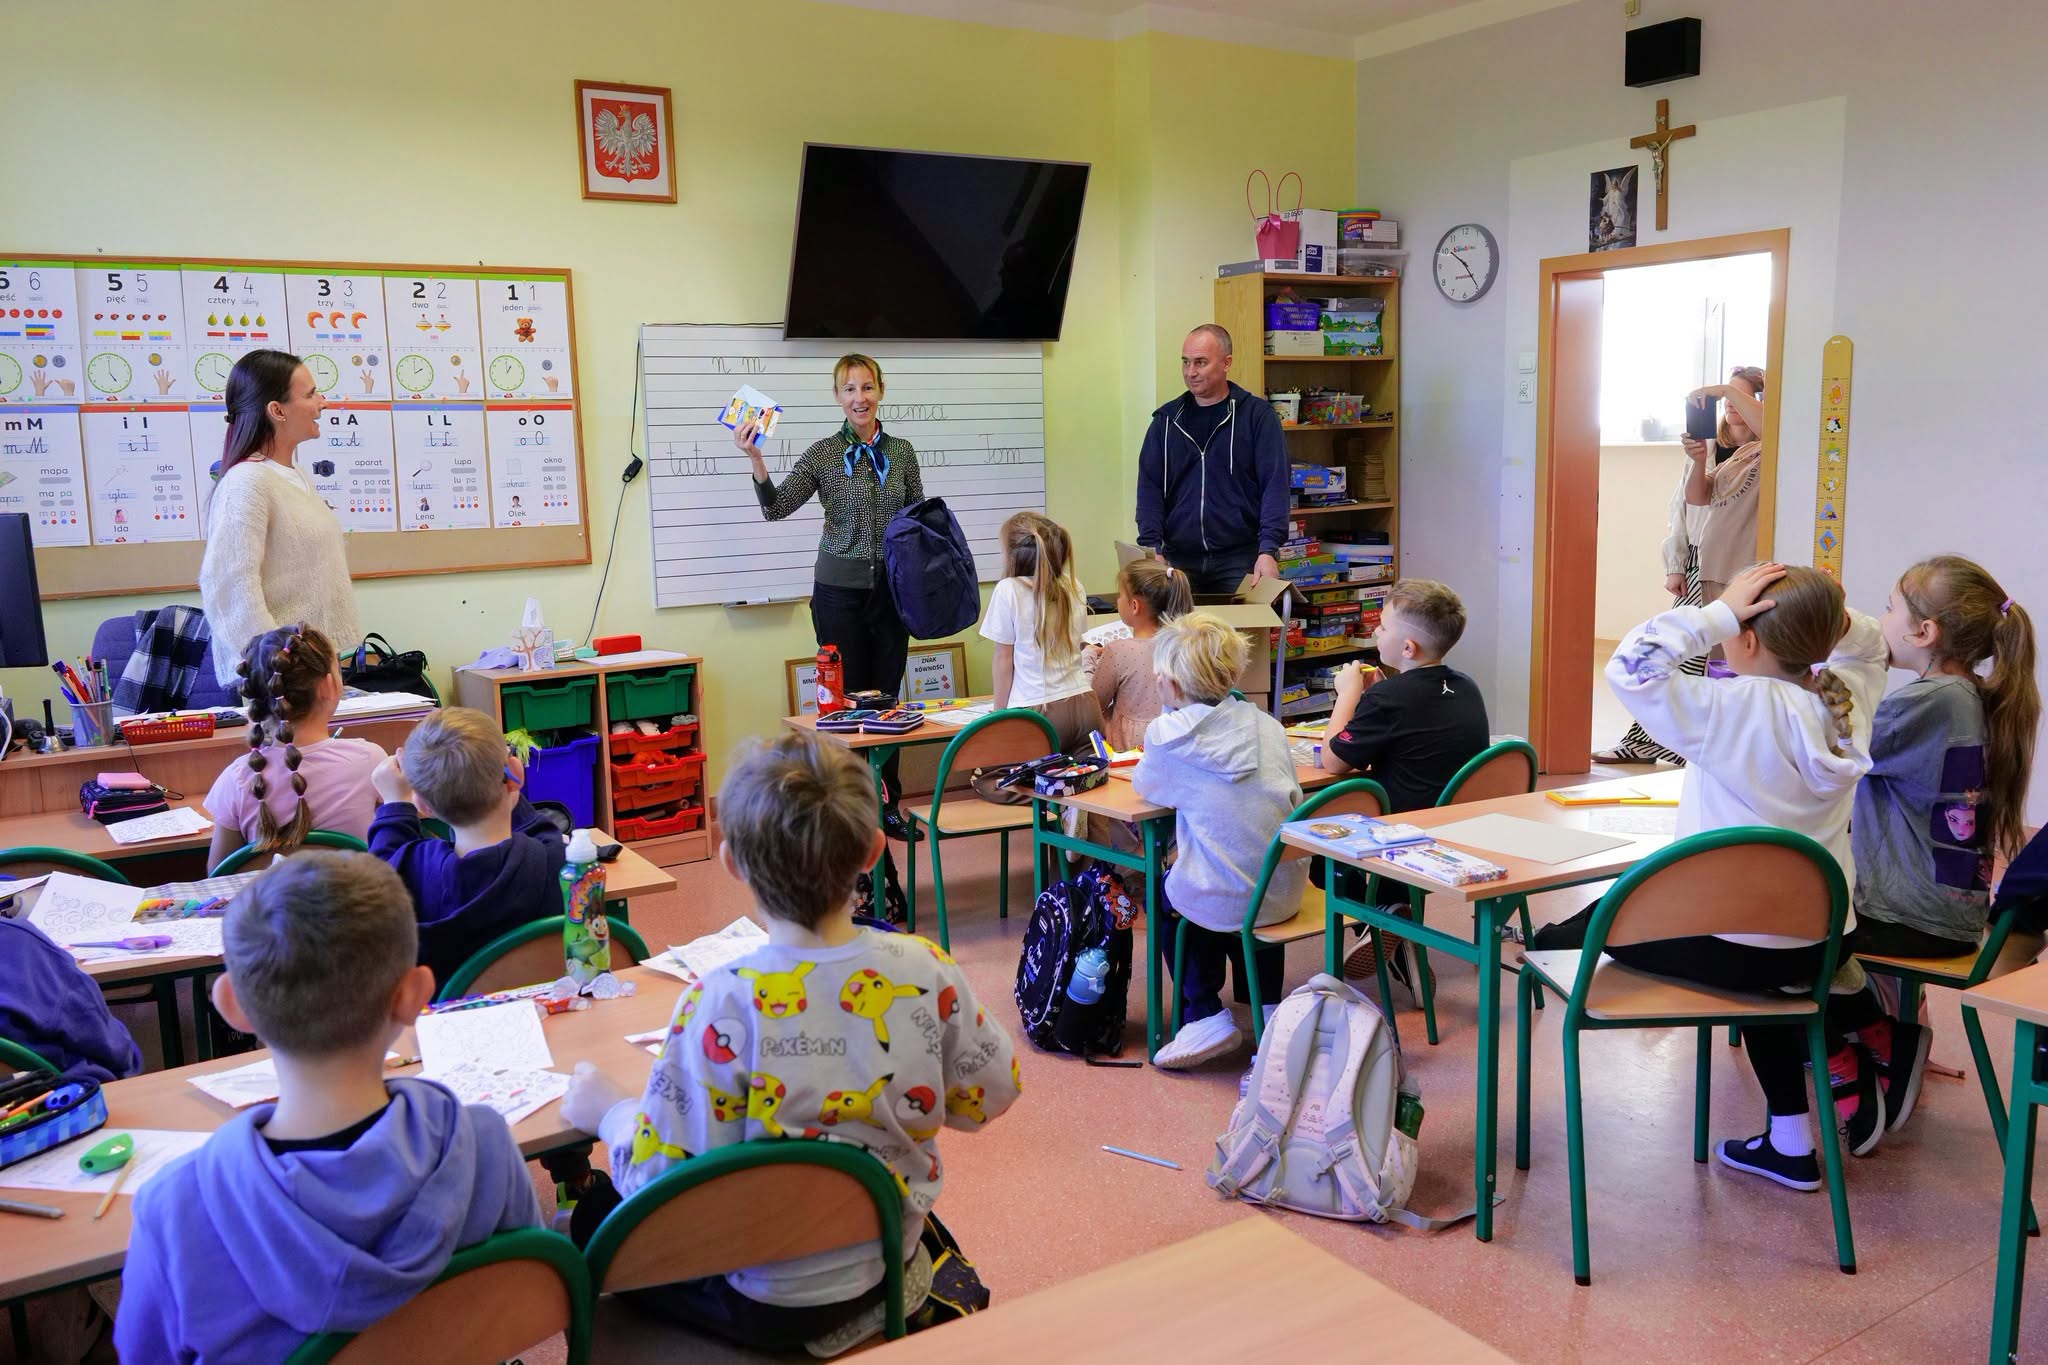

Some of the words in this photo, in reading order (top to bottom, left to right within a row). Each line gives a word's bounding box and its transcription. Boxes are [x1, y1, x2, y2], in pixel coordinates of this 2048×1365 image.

[1462, 228, 1469, 236] 12
[1442, 248, 1449, 256] 10
[29, 272, 41, 291] 6
[108, 273, 123, 292] 5
[136, 274, 148, 293] 5
[214, 276, 230, 294] 4
[243, 276, 254, 295] 4
[1442, 278, 1446, 287] 8
[318, 279, 331, 297] 3
[343, 280, 353, 297] 3
[412, 282, 426, 299] 2
[436, 282, 447, 300] 2
[508, 284, 519, 301] 1
[530, 284, 536, 301] 1
[1450, 288, 1455, 297] 7
[106, 295, 127, 304] pięć
[208, 297, 236, 306] cztery
[318, 300, 335, 308] trzy
[412, 301, 429, 309] dwa
[502, 304, 524, 313] jeden
[712, 356, 732, 375] n
[742, 356, 767, 375] m
[5, 420, 23, 431] m
[27, 418, 43, 431] M
[123, 416, 129, 429] i
[330, 416, 340, 426] a
[347, 414, 359, 426] A
[428, 414, 434, 426] l
[443, 414, 452, 426] L
[518, 417, 528, 426] o
[534, 414, 545, 426] O
[332, 438, 343, 447] a
[346, 431, 361, 447] A
[430, 432, 437, 447] l
[442, 432, 453, 447] L
[520, 437, 527, 446] o
[535, 430, 544, 446] O
[4, 444, 23, 454] m
[25, 436, 49, 454] M
[128, 440, 138, 452] i
[978, 433, 1024, 466] Tom
[454, 458, 472, 467] lupa
[544, 456, 563, 464] okno
[666, 441, 724, 477] tata
[40, 466, 69, 476] mapa
[156, 464, 174, 473] igła
[453, 476, 462, 484] lu
[466, 477, 477, 485] pa
[154, 484, 164, 494] ig
[39, 490, 55, 498] ma
[60, 490, 73, 499] pa
[0, 496, 19, 507] apa
[415, 513, 435, 521] Lena
[508, 510, 527, 518] Olek
[114, 525, 129, 533] Ida
[921, 656, 937, 664] ZNAK
[914, 664, 945, 673] RÓWNOŚCI
[760, 1030, 847, 1056] POKÉMON
